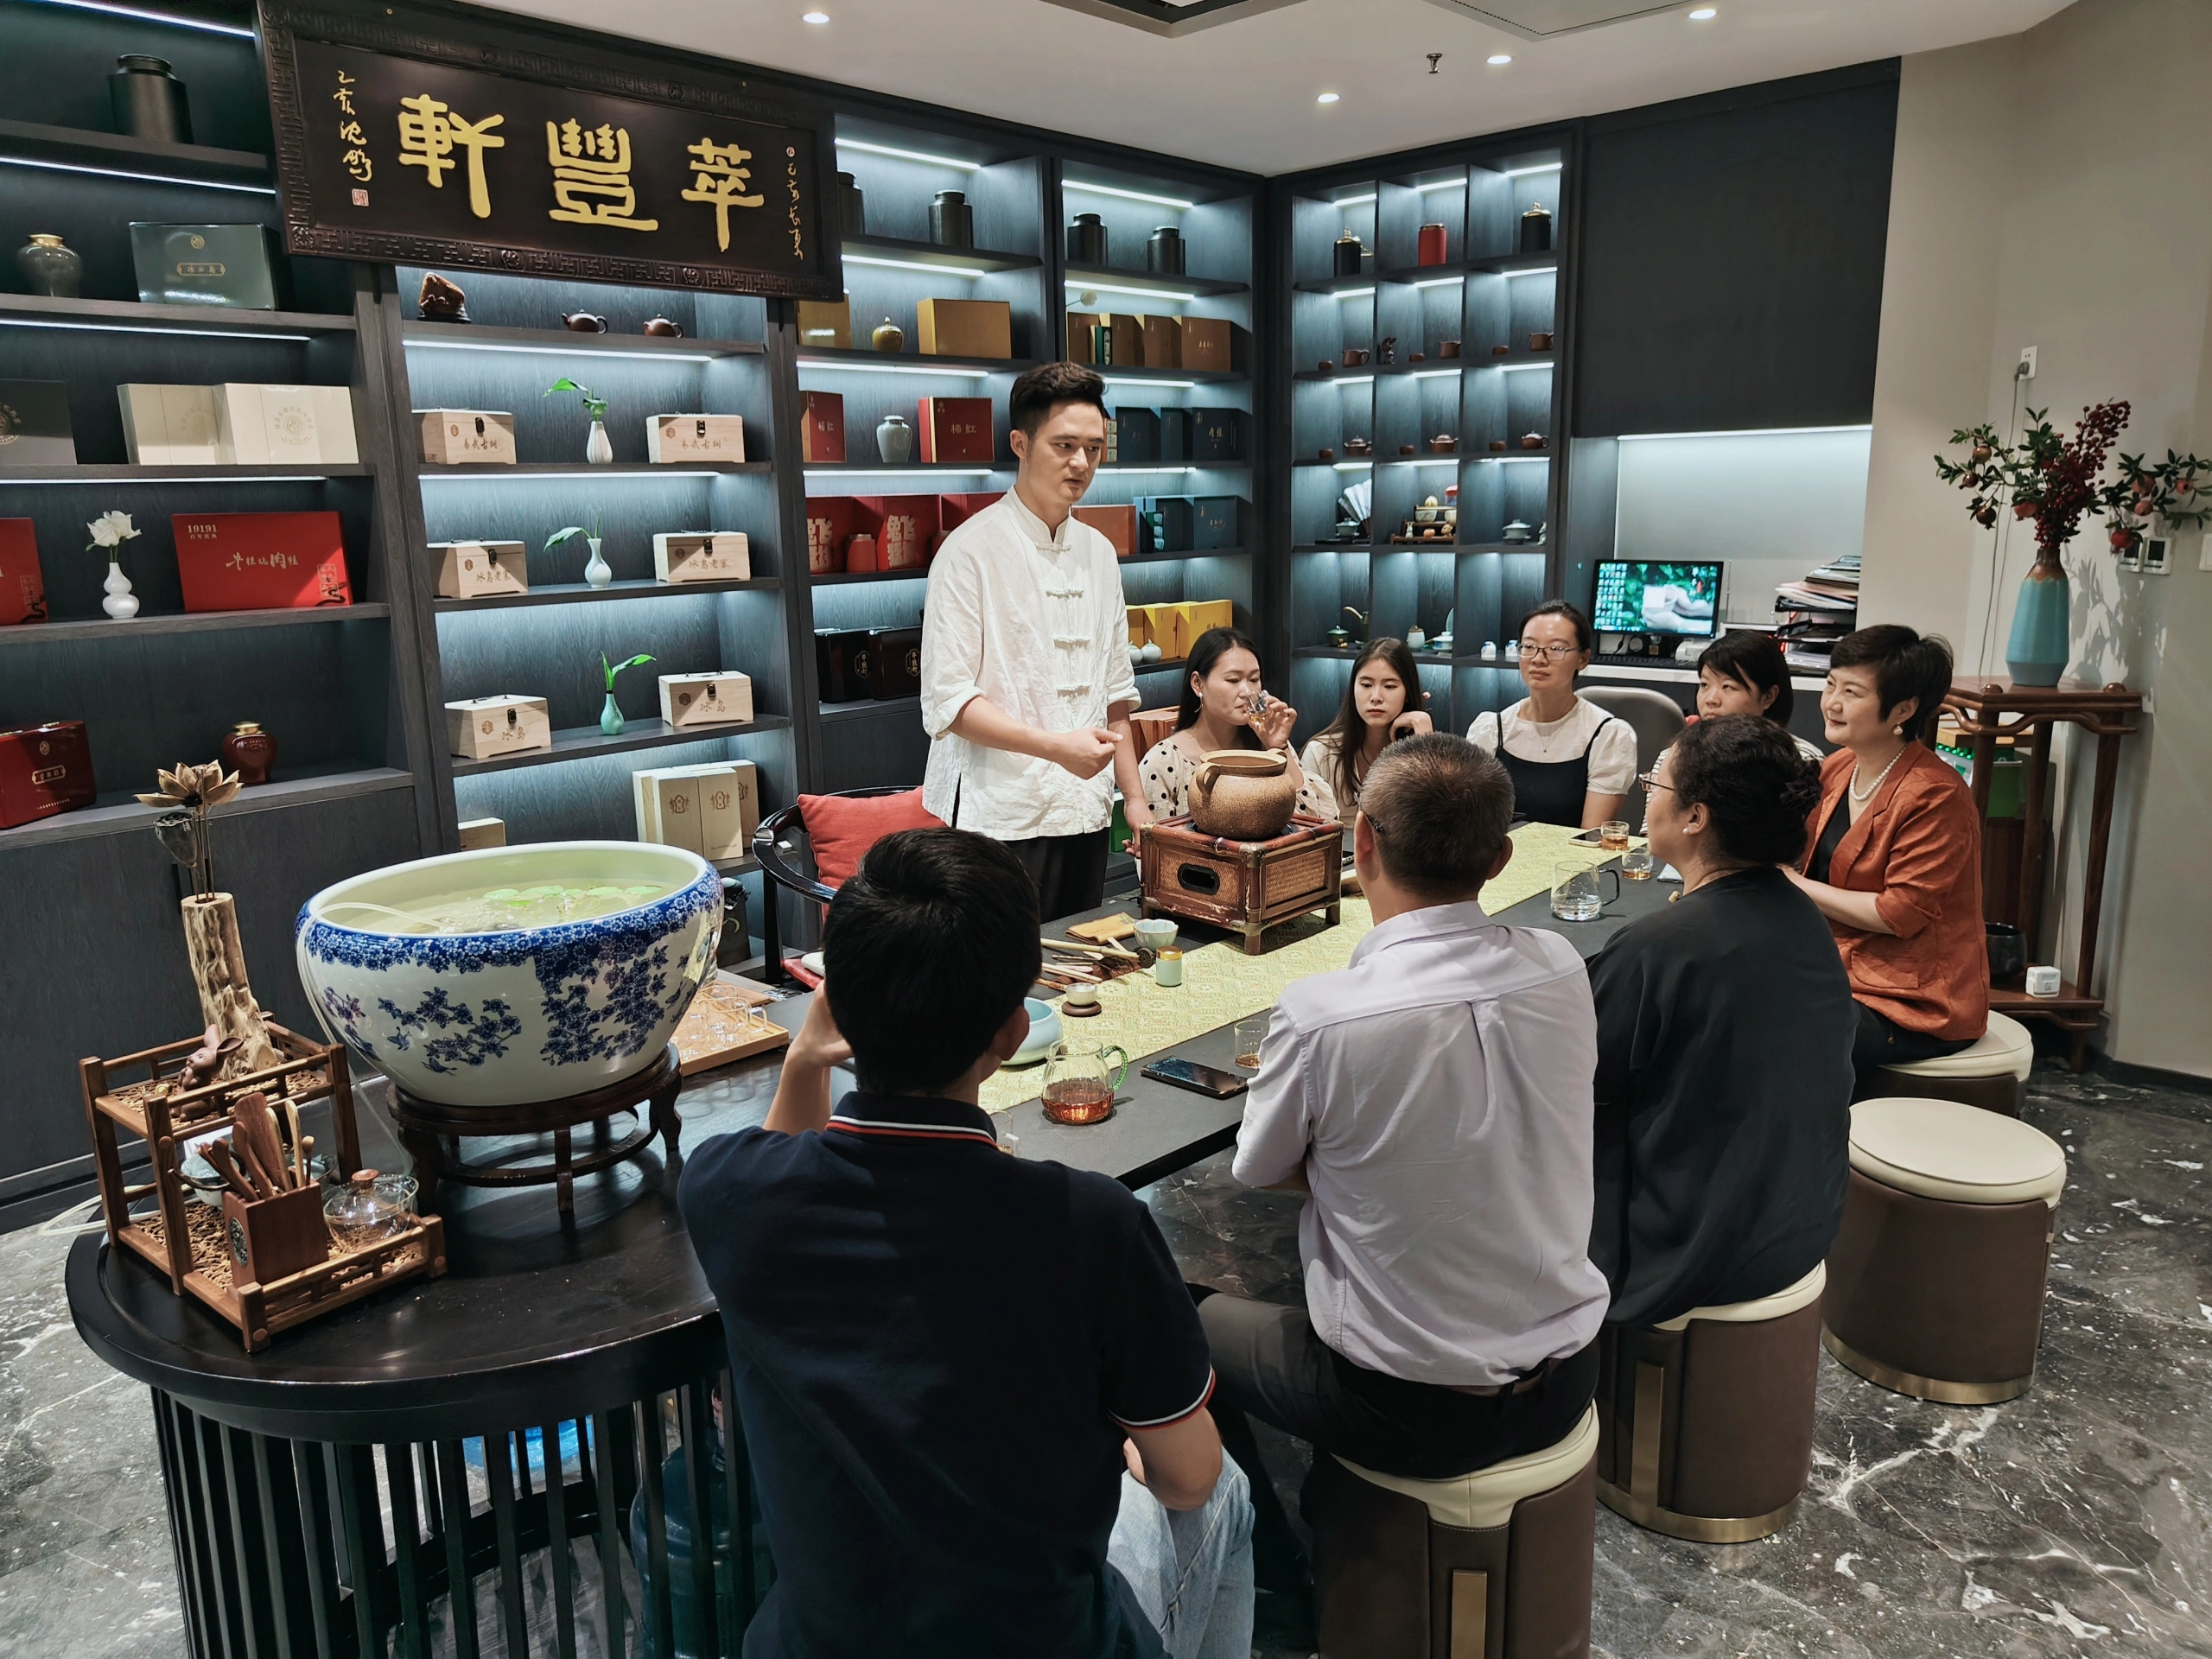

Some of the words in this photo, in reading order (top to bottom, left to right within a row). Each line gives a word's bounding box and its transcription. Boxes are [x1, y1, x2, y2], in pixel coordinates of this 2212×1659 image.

[188, 524, 218, 533] 19191
[701, 700, 725, 712] 冰岛
[502, 726, 525, 741] 冰岛
